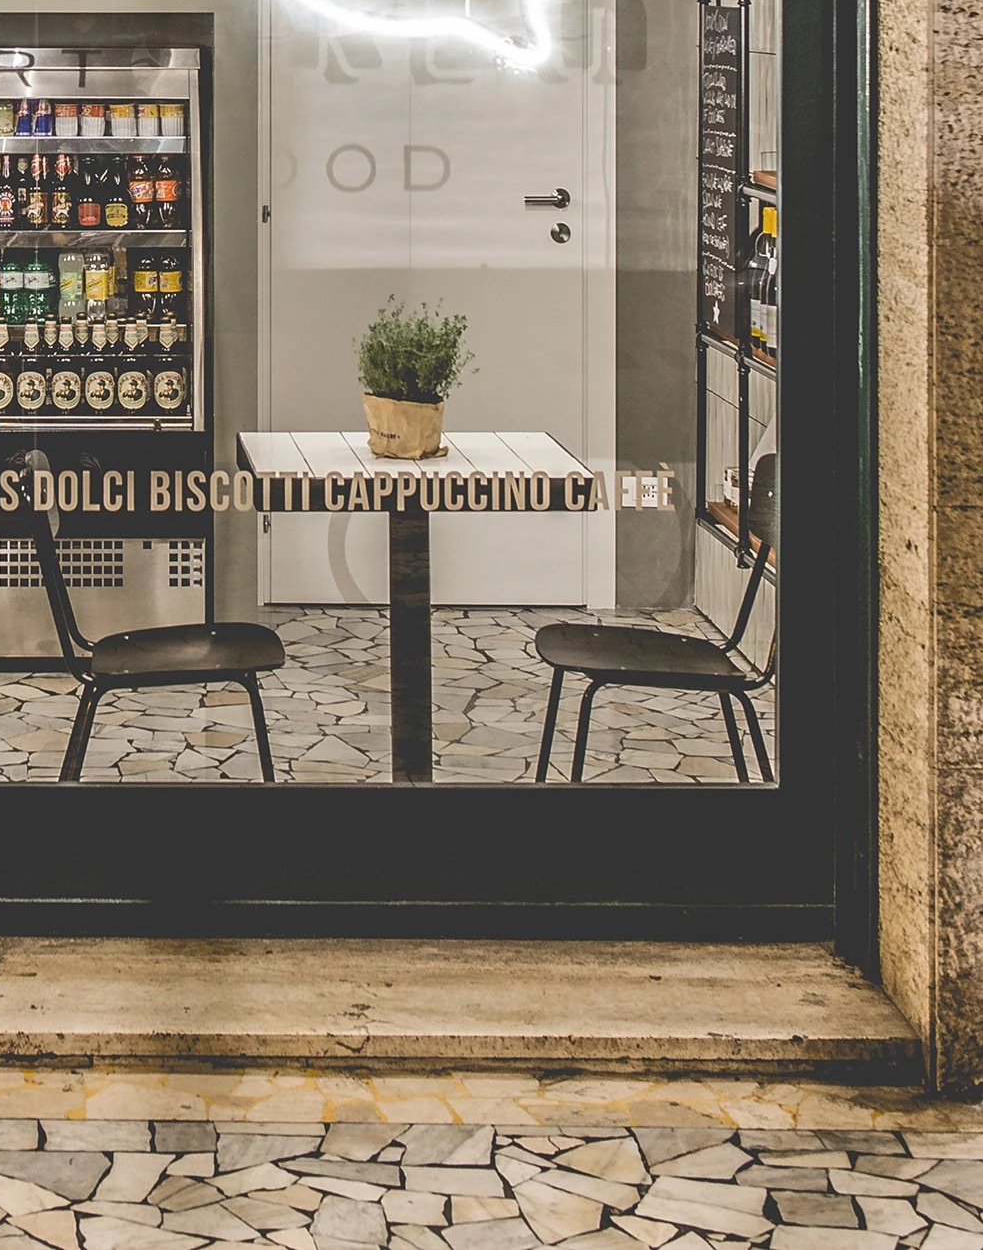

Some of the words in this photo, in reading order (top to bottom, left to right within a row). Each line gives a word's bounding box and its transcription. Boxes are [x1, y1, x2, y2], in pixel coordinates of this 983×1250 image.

[33, 469, 136, 512] DOLCI
[149, 469, 312, 512] BISCOTTI
[323, 469, 548, 512] CAPPUCCINO
[564, 461, 677, 511] CAFFÈ
